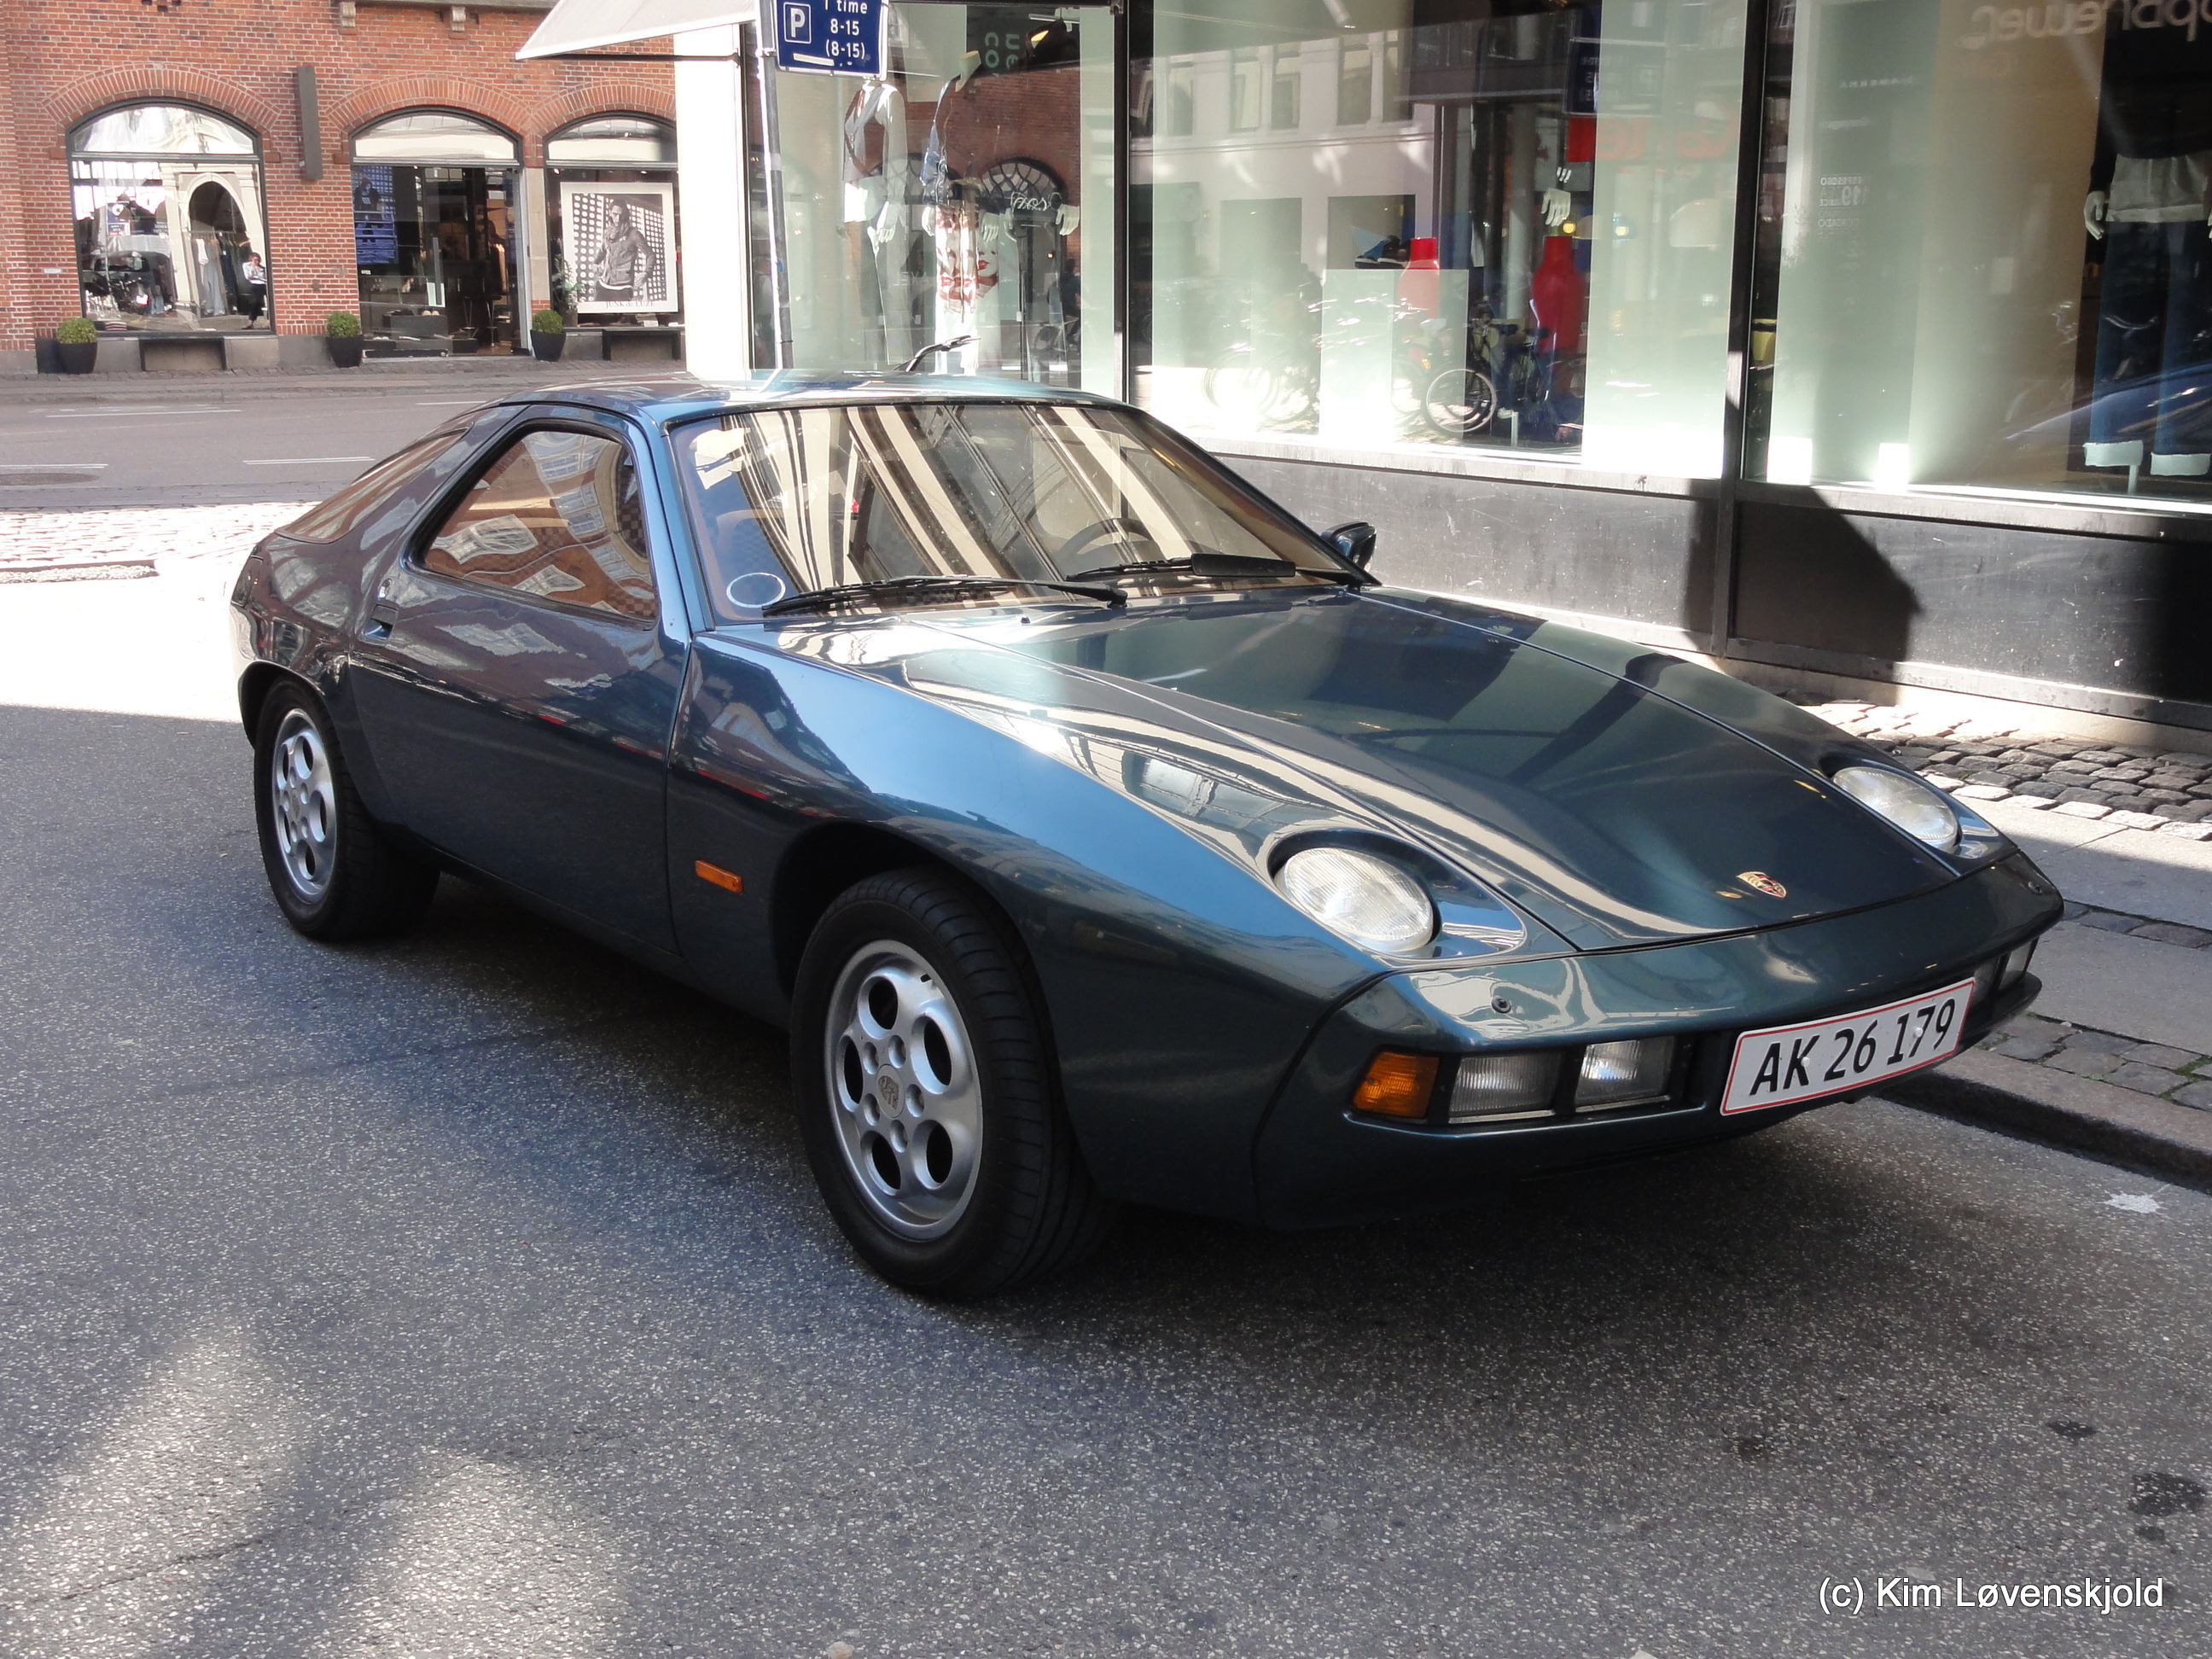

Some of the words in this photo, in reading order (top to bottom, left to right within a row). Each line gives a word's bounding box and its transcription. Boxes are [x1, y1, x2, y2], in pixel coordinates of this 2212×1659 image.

[836, 0, 868, 14] time
[830, 18, 860, 36] 8-15
[825, 39, 866, 60] (8-15)
[1749, 1034, 1820, 1097] AK
[1823, 1019, 1878, 1082] 26
[1887, 998, 1955, 1065] 179
